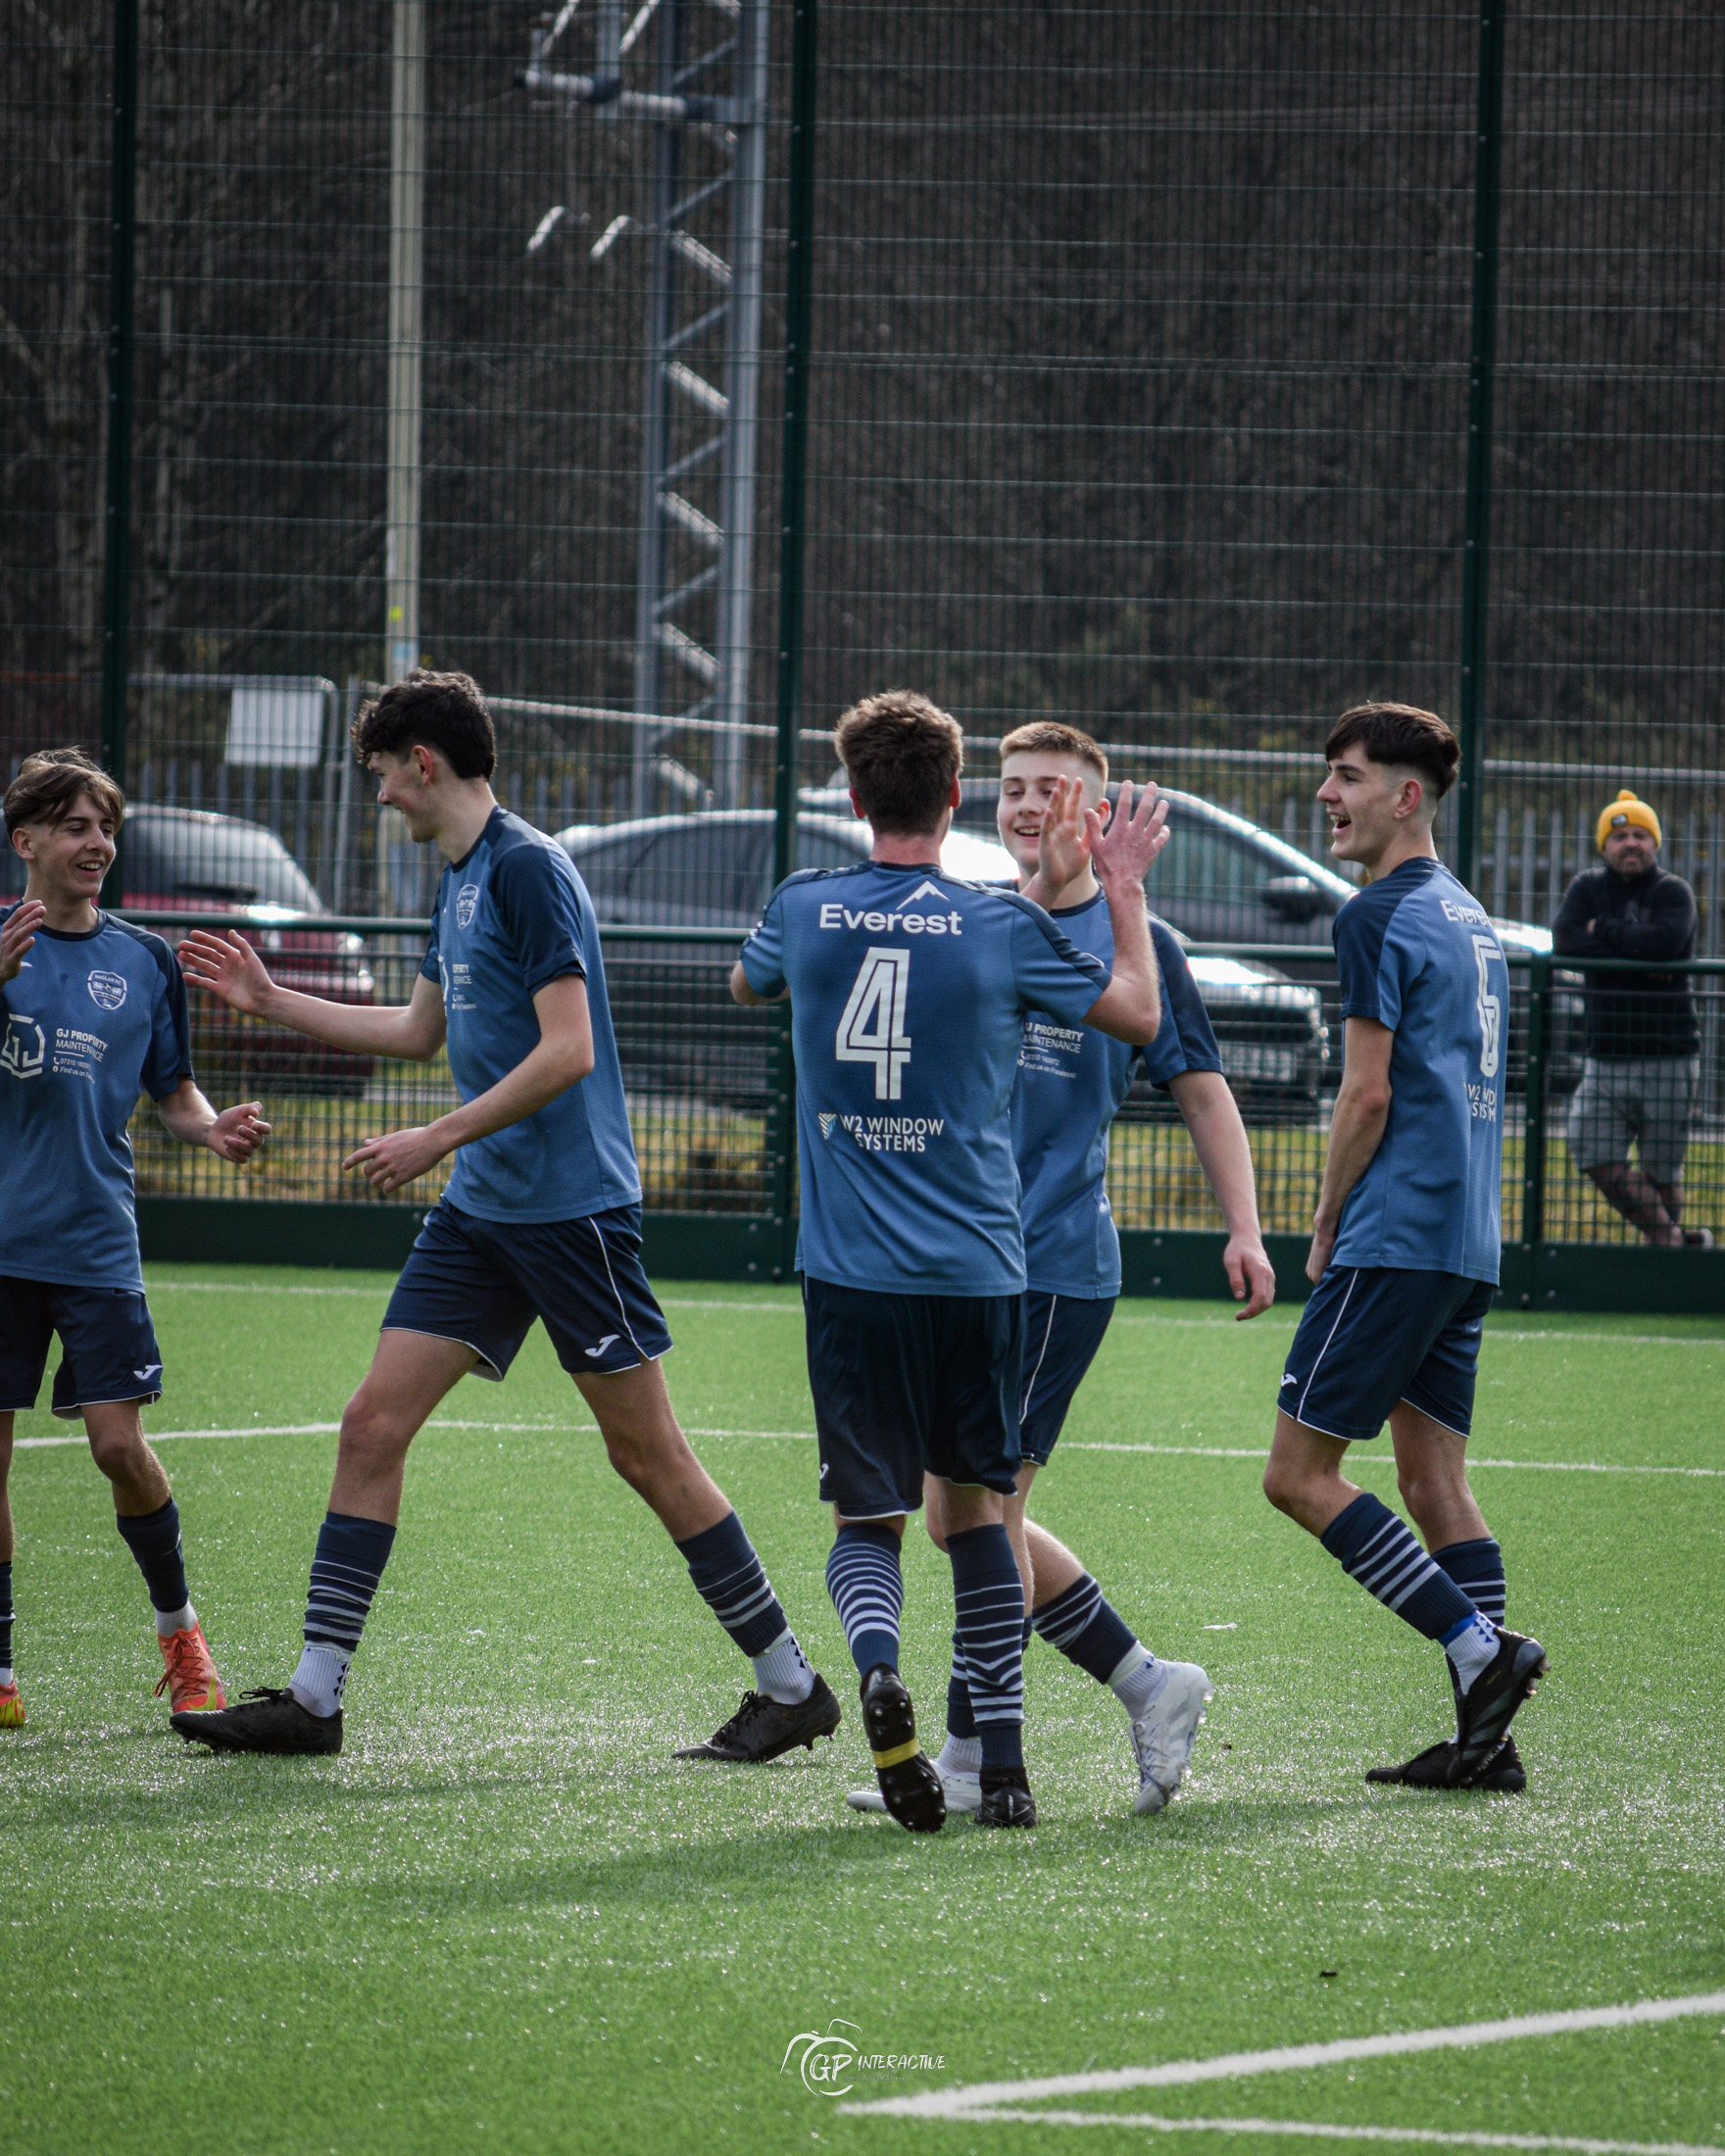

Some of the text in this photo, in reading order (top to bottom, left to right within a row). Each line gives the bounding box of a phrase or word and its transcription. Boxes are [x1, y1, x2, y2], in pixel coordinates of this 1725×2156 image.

[819, 904, 962, 935] Everest
[1440, 900, 1491, 926] Evere
[836, 947, 912, 1100] 4
[1034, 1023, 1084, 1042] PROPERTY
[56, 1027, 109, 1052] GJ PROPERTY
[840, 1114, 945, 1136] W2 WINDOW
[856, 1132, 926, 1152] SYSTEMS
